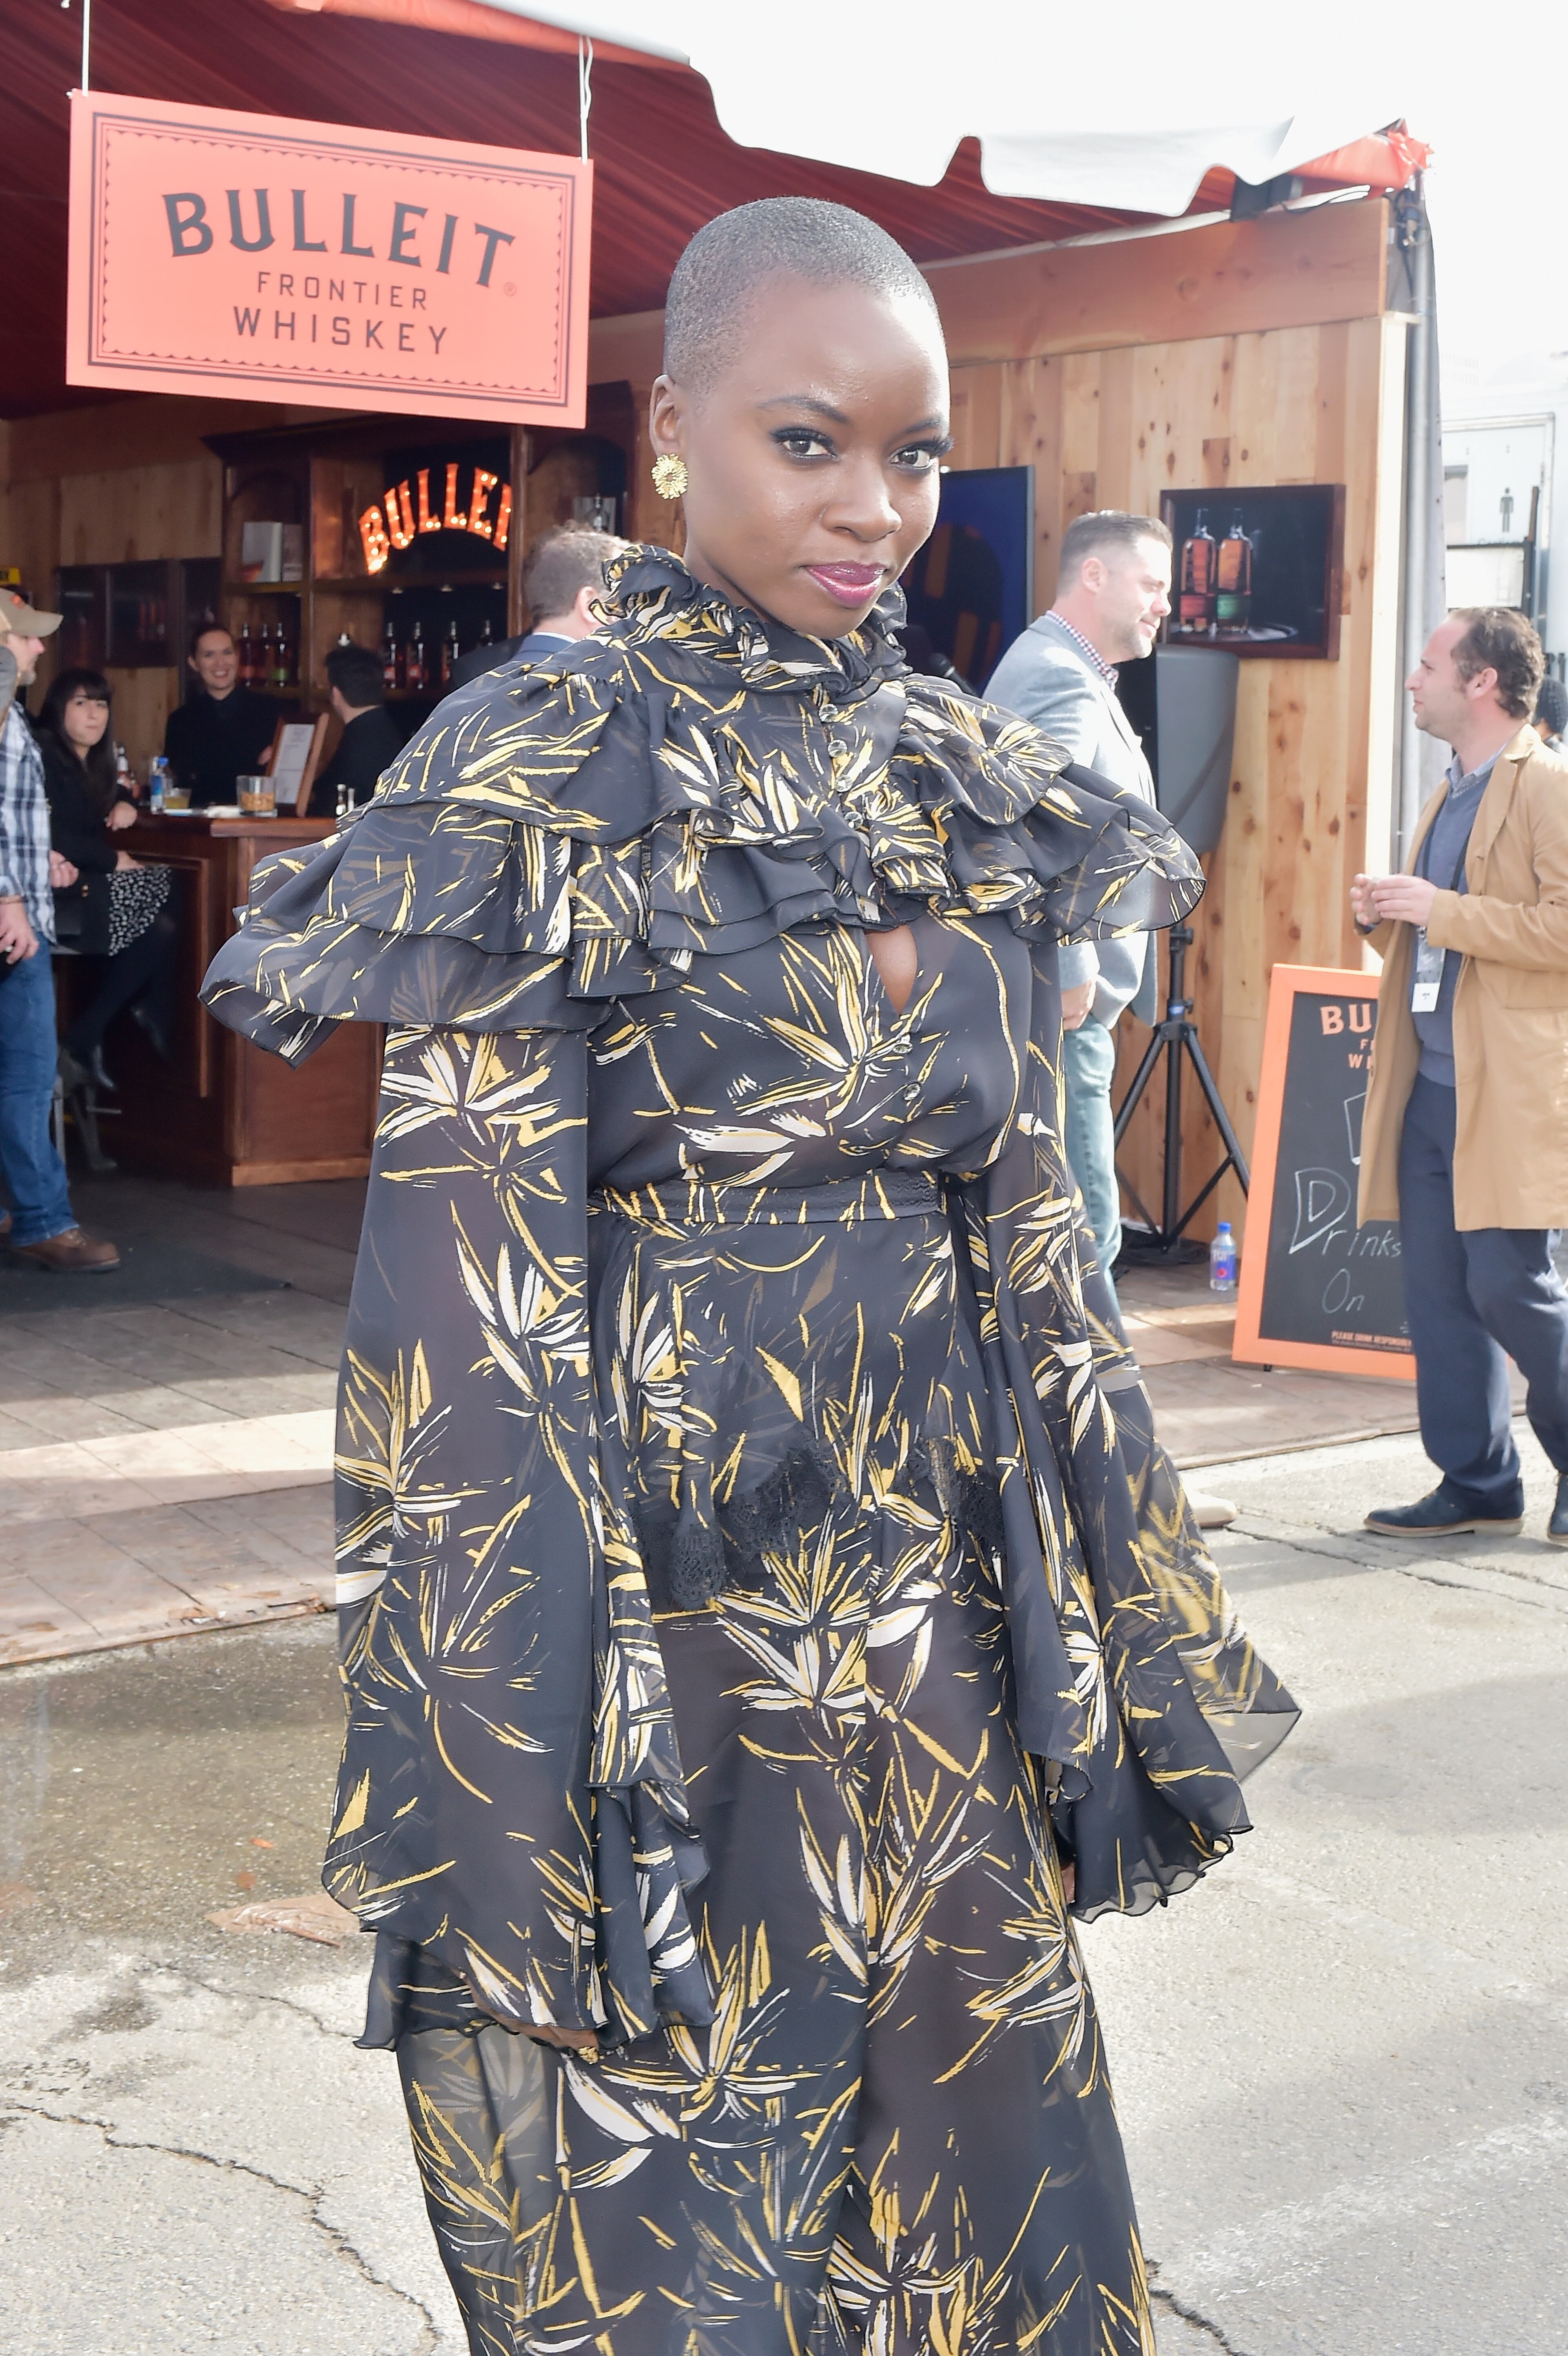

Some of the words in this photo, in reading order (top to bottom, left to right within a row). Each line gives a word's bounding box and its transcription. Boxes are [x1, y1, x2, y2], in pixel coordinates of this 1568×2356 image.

[163, 188, 515, 288] BULLEIT
[257, 271, 427, 310] FRONTIER
[234, 306, 447, 354] WHISKEY
[1289, 1167, 1401, 1258] Drinks
[1323, 1268, 1364, 1313] On
